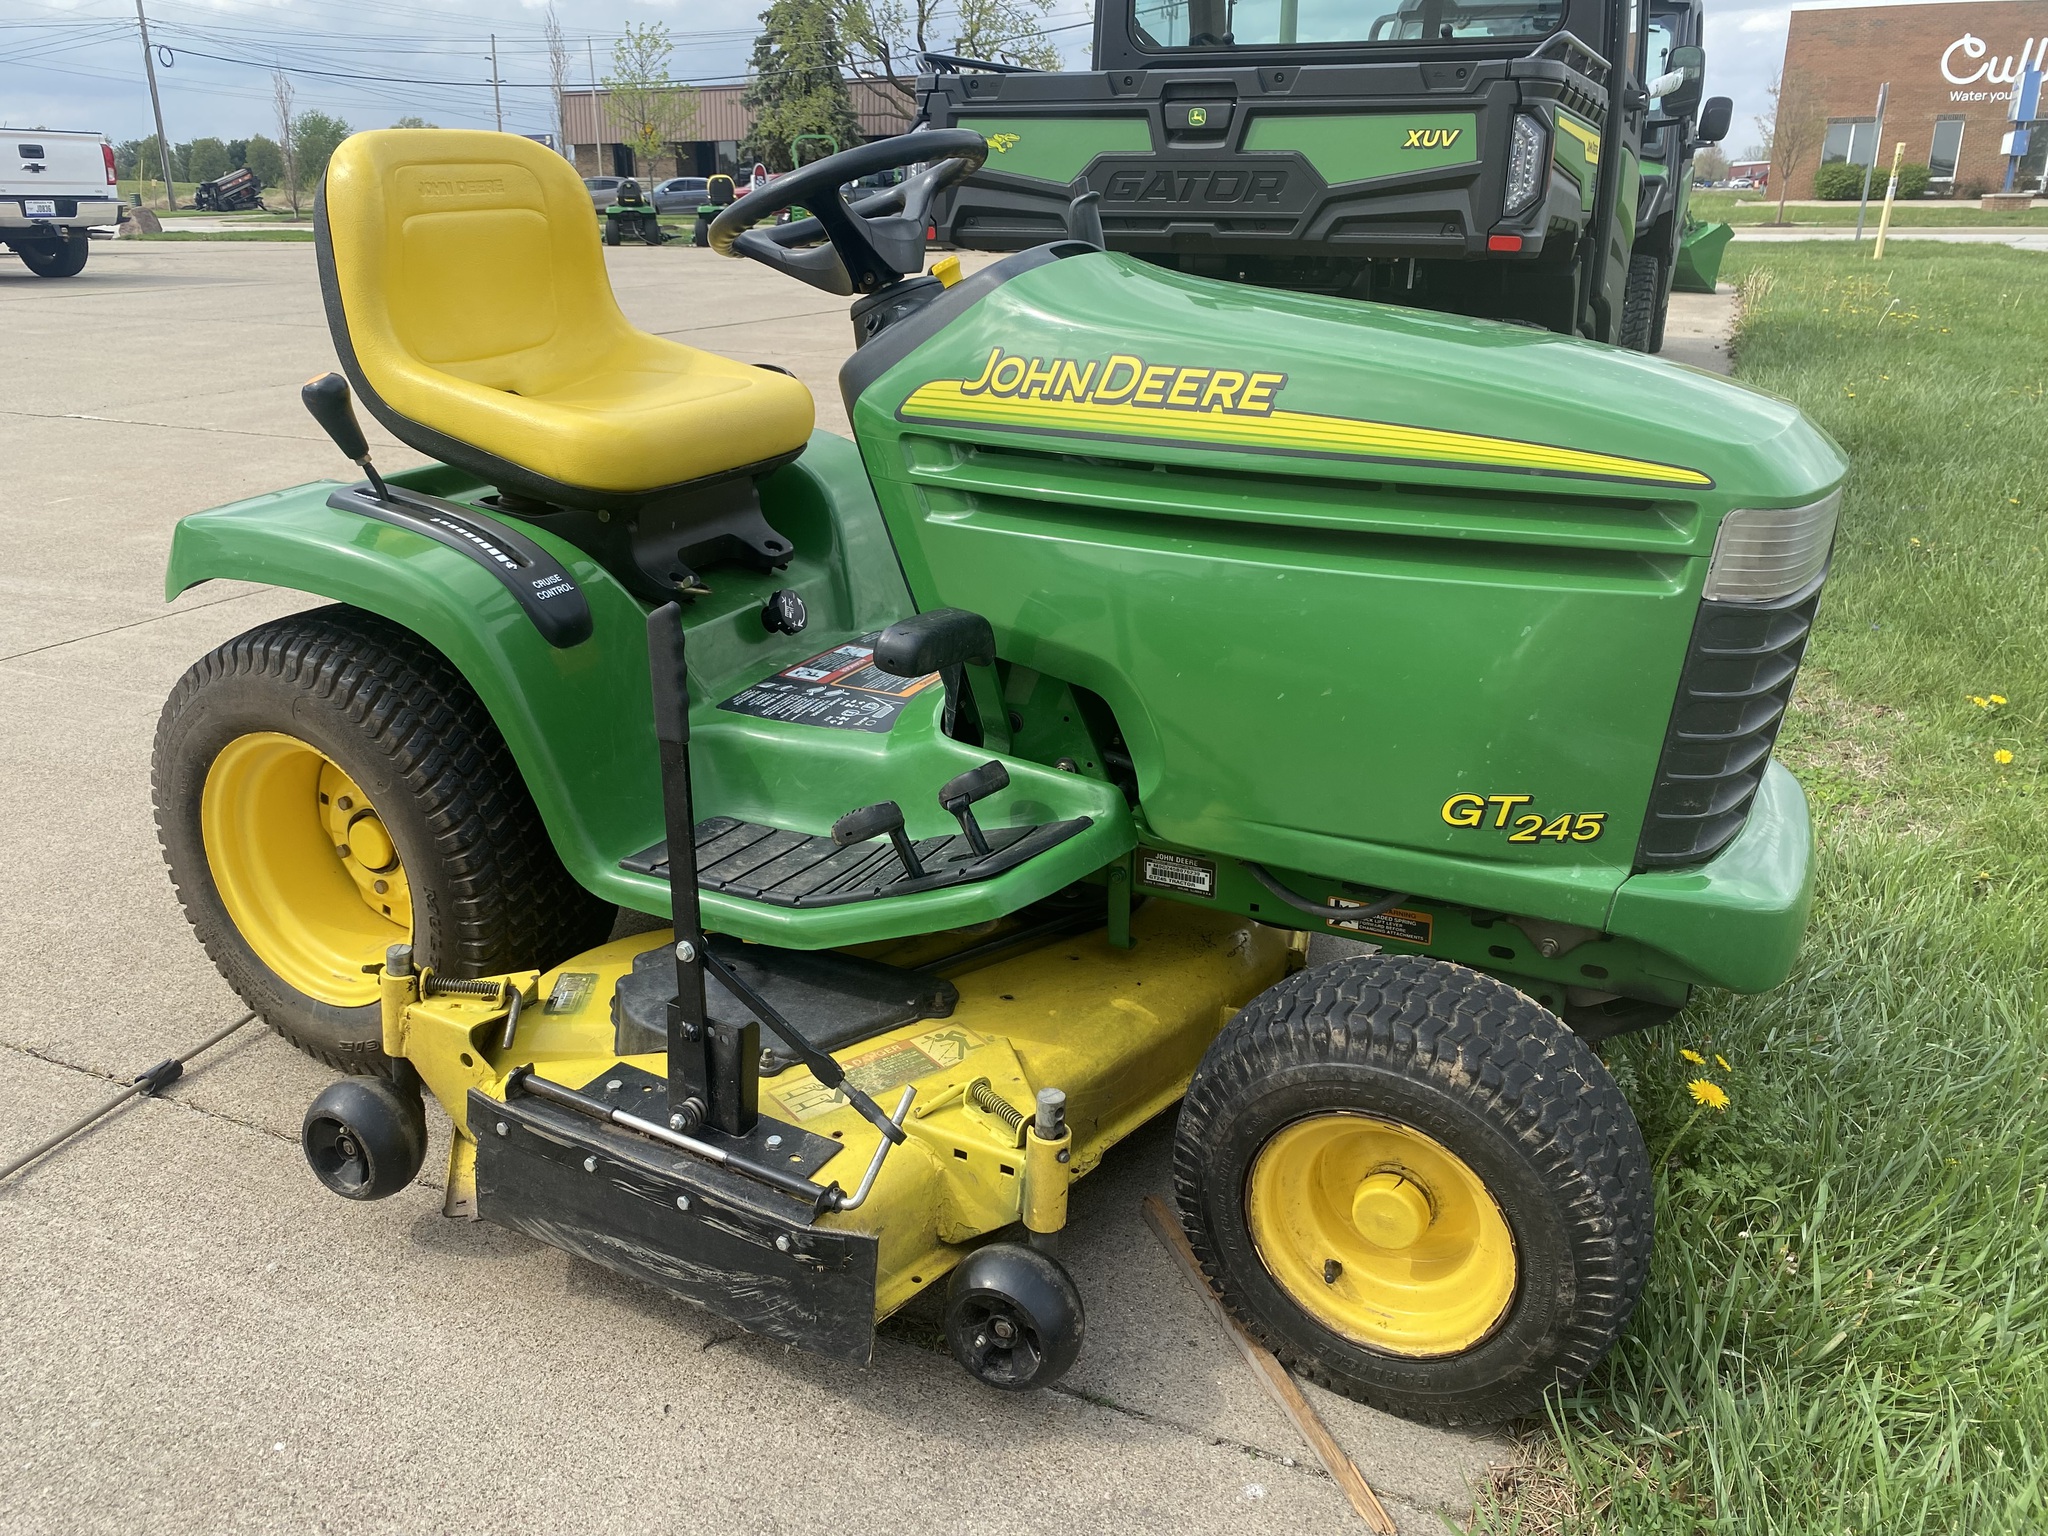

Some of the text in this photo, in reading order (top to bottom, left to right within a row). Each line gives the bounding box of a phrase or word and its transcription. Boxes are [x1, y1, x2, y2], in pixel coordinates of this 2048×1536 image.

[1941, 33, 2048, 84] Cull
[1949, 91, 2013, 103] Water you
[1401, 129, 1463, 149] XUV
[456, 179, 505, 196] DEERE
[1103, 170, 1290, 204] GATOR
[961, 346, 1289, 417] JOHN DEERE
[532, 573, 562, 589] CRUISE
[536, 583, 575, 600] CONTROL
[1155, 853, 1174, 862] JOHN
[1176, 857, 1198, 867] DEERE
[1169, 878, 1196, 888] TRACTOR
[1386, 909, 1417, 919] ARNING
[1386, 930, 1424, 941] ATTACHMENTS
[852, 1045, 902, 1067] DANGER
[1314, 1342, 1431, 1388] CARLISLE
